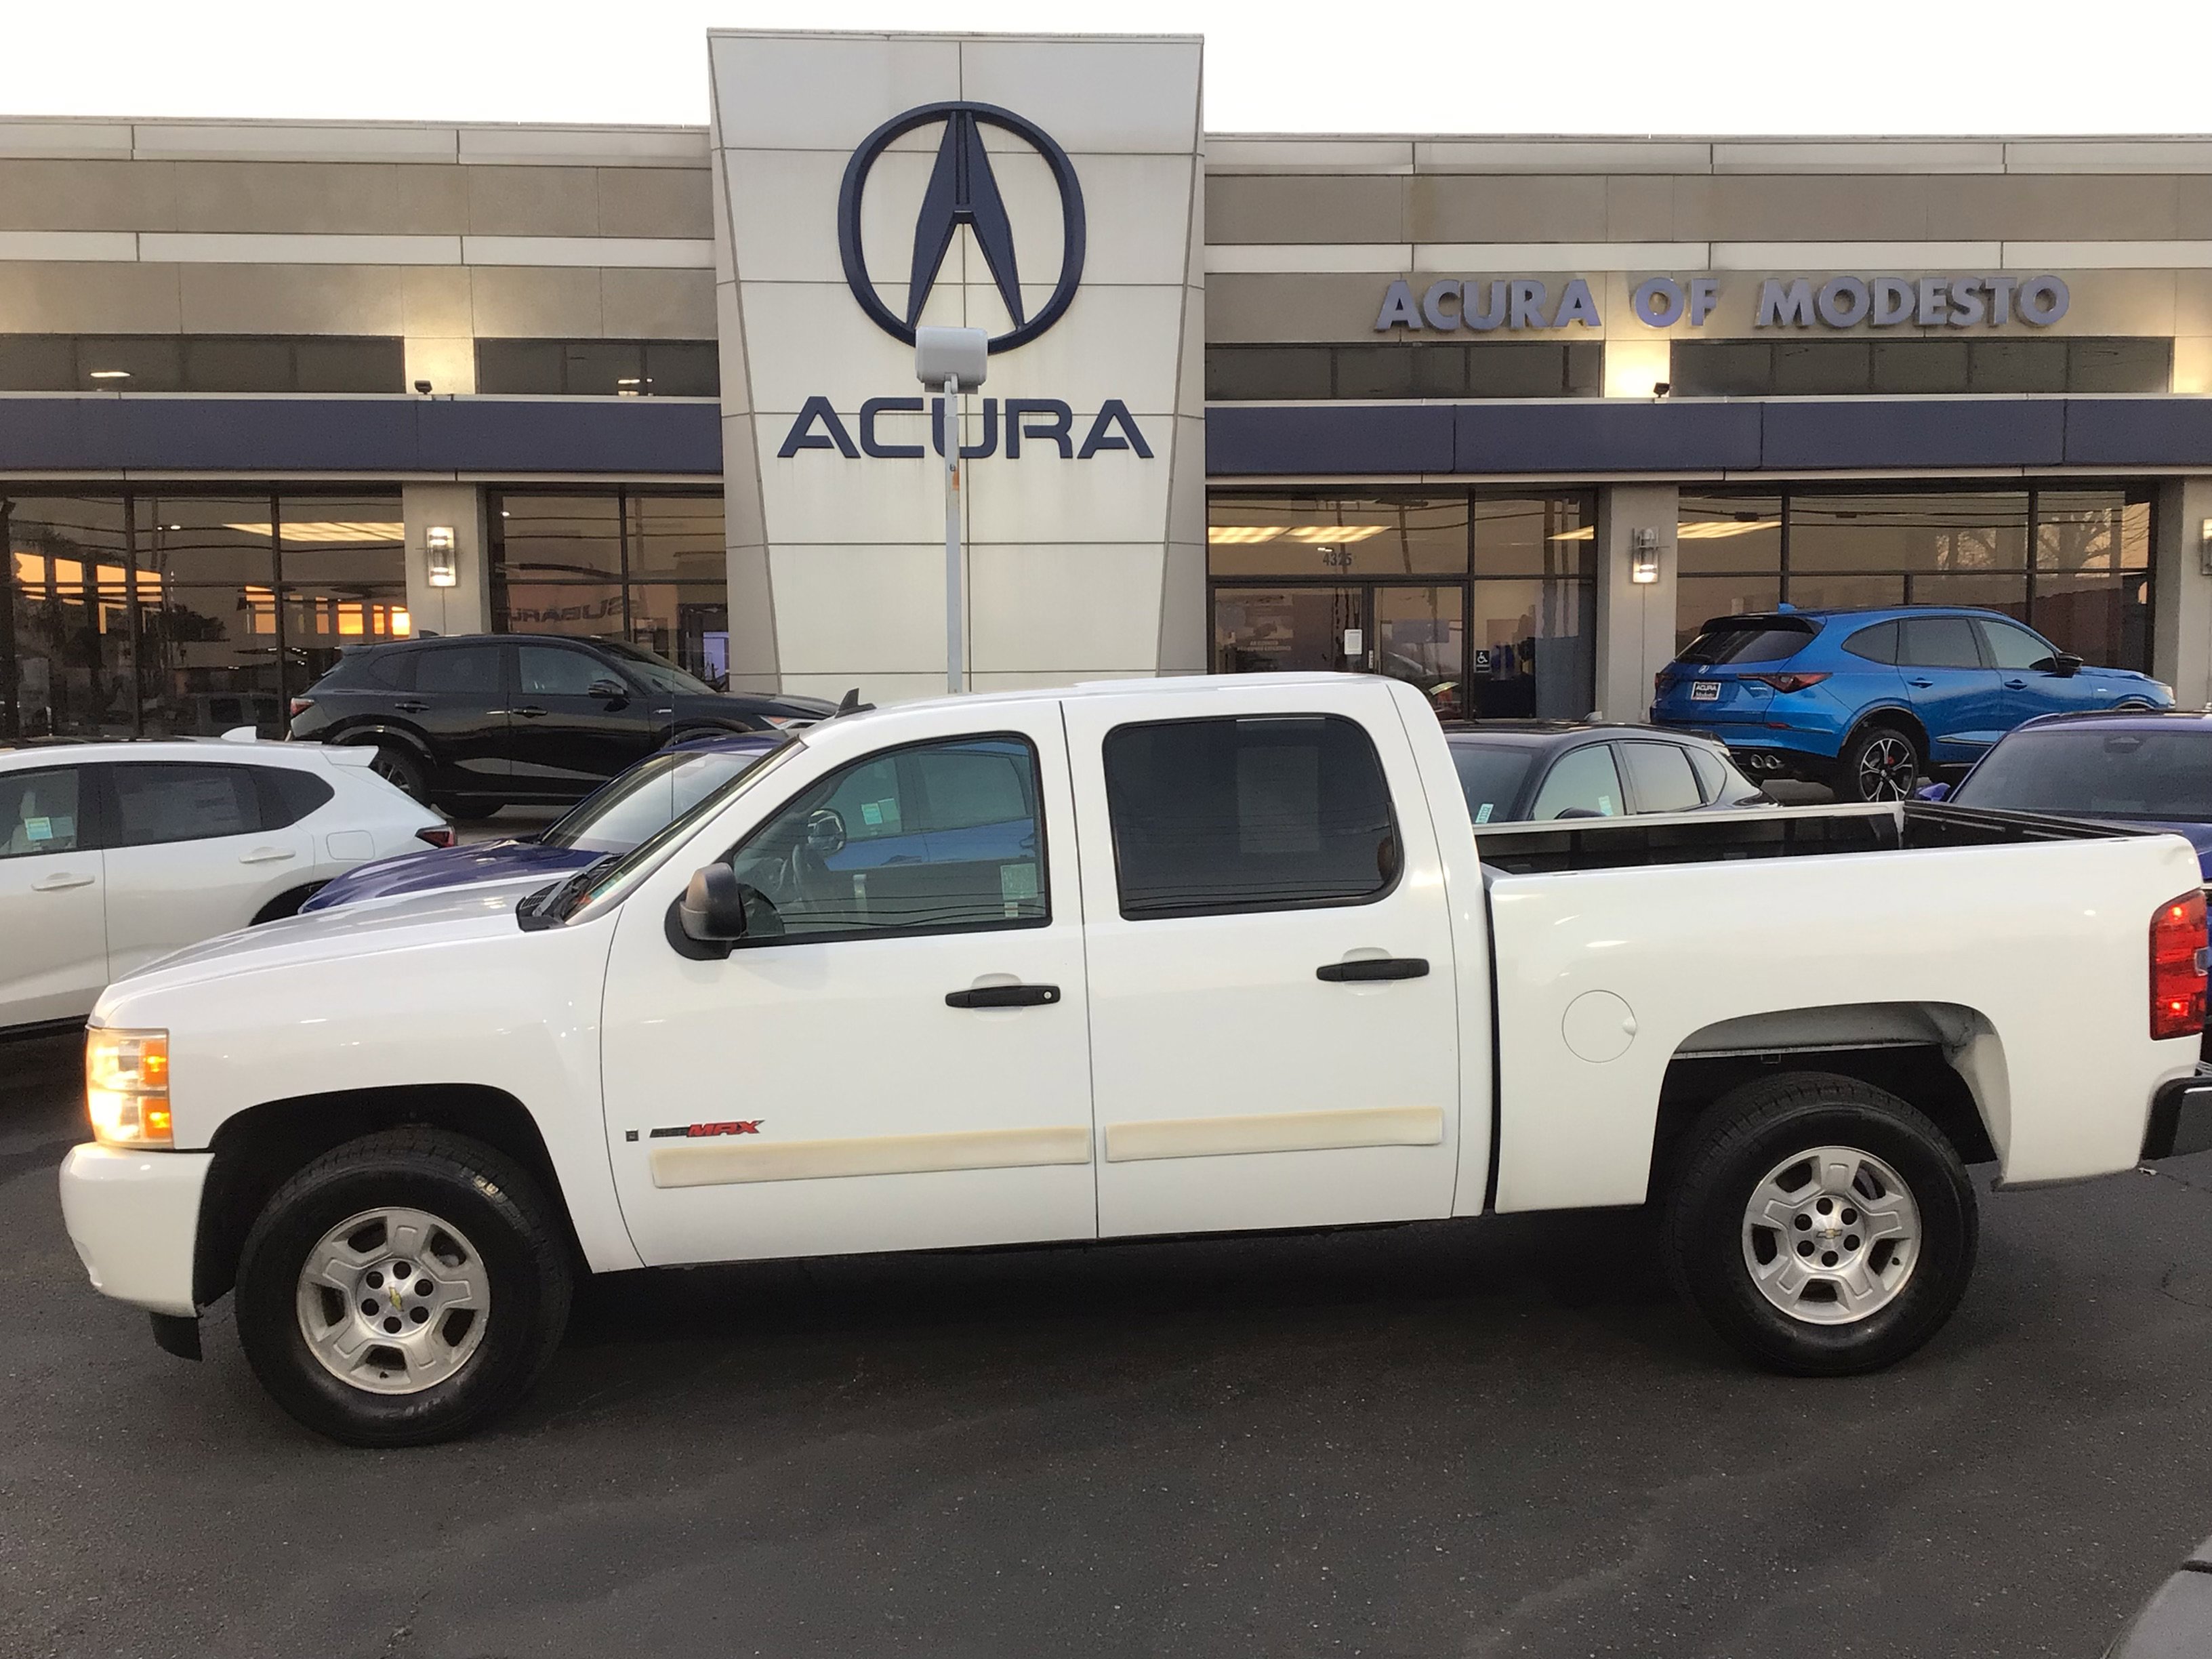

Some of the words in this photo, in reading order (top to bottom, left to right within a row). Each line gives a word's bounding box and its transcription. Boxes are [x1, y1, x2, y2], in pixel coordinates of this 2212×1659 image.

[1375, 278, 1602, 331] ACURA
[1633, 276, 1719, 328] OF
[1755, 275, 2071, 328] MODESTO
[777, 396, 1154, 459] ACURA
[1322, 552, 1352, 566] 4325
[687, 1120, 765, 1137] MAX
